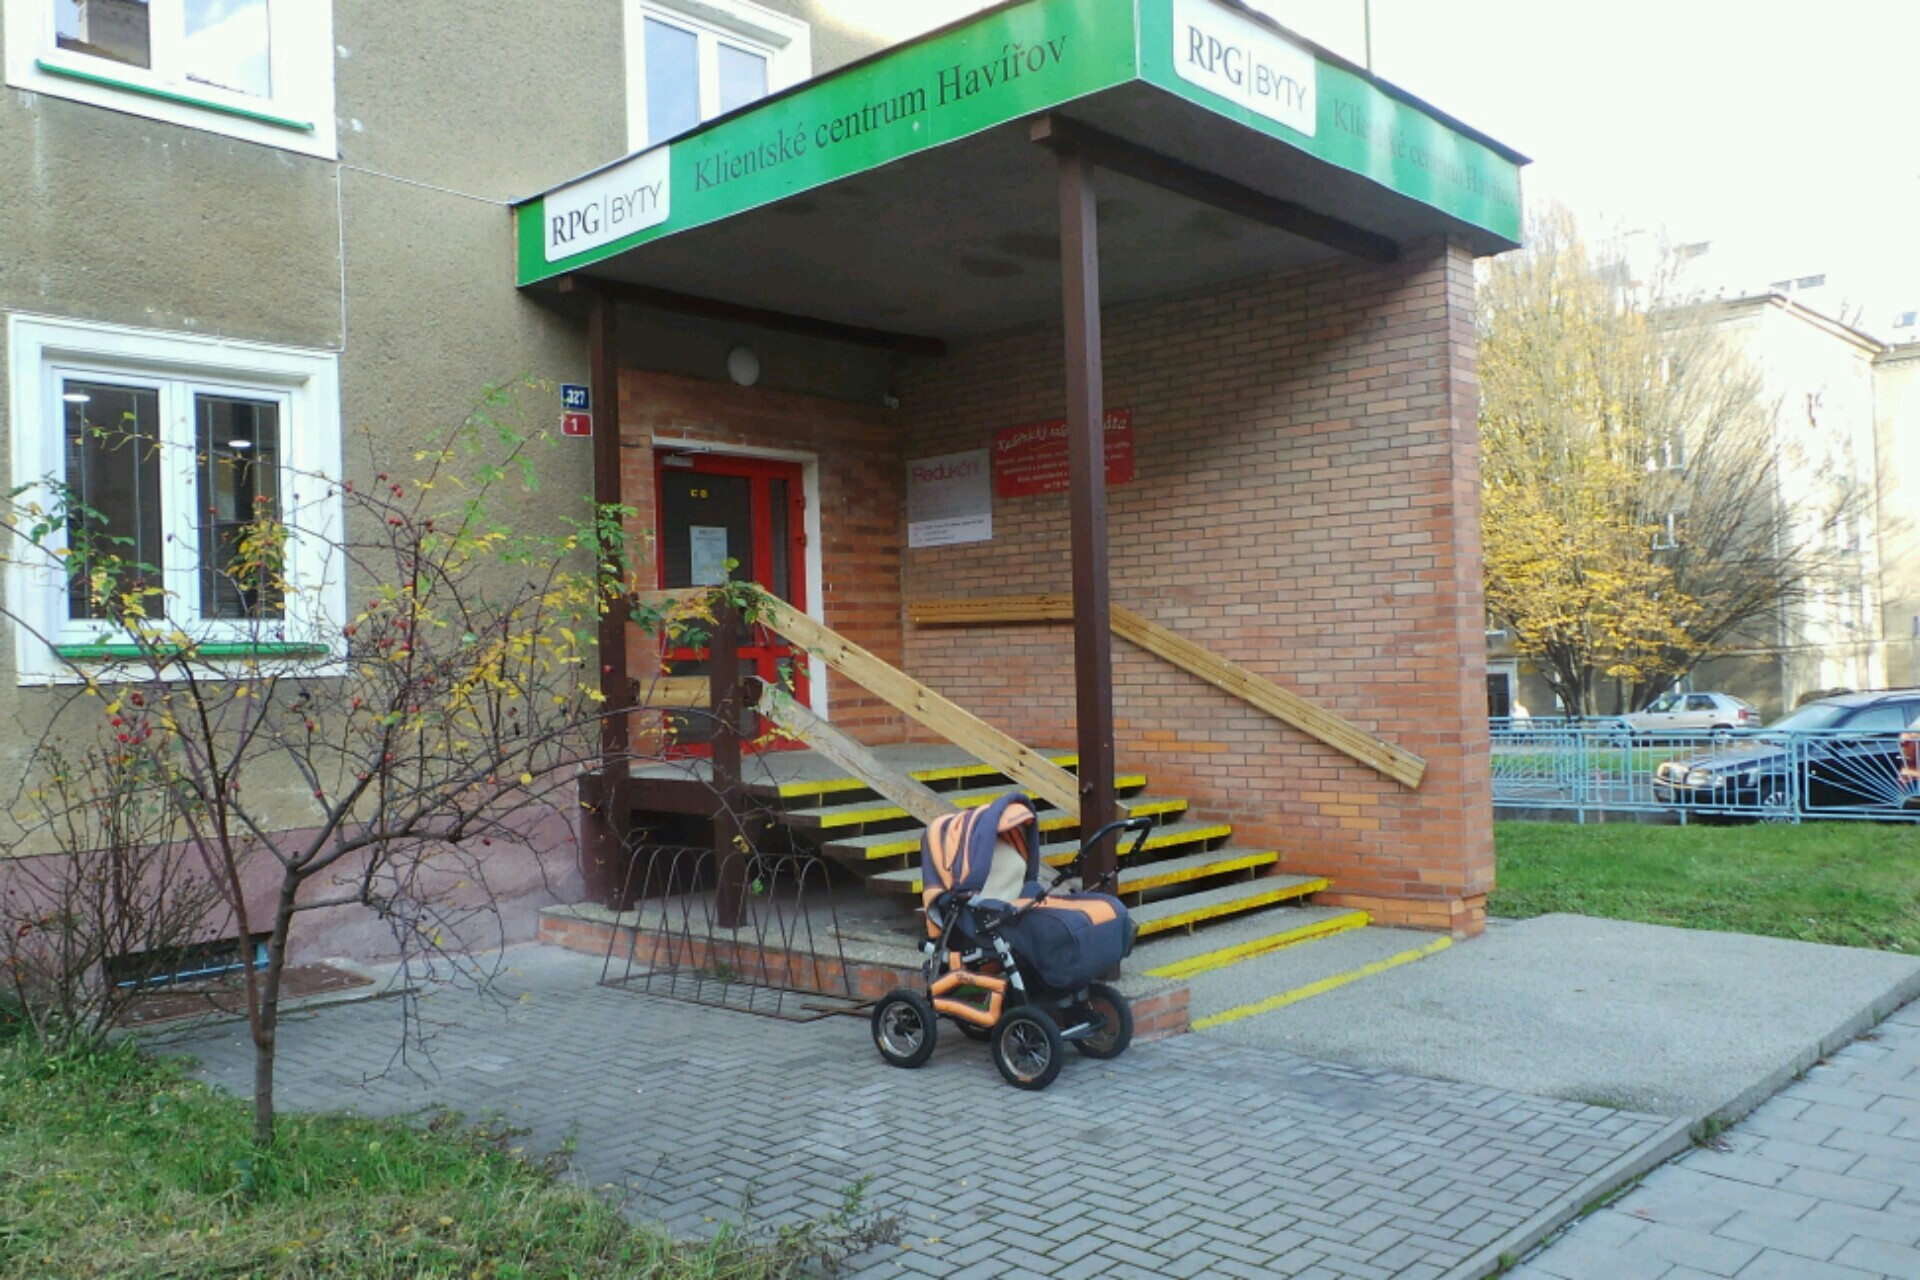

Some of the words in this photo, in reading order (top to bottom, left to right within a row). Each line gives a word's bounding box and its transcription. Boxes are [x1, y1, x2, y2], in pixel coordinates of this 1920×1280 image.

[1187, 26, 1243, 86] RPG
[1256, 64, 1307, 112] BYTY
[693, 121, 807, 192] Klientské
[815, 87, 928, 149] centrum
[937, 34, 1069, 106] Havířov
[550, 202, 600, 248] RPG
[611, 180, 663, 225] BYTY
[567, 389, 586, 406] 327
[569, 417, 578, 431] 1
